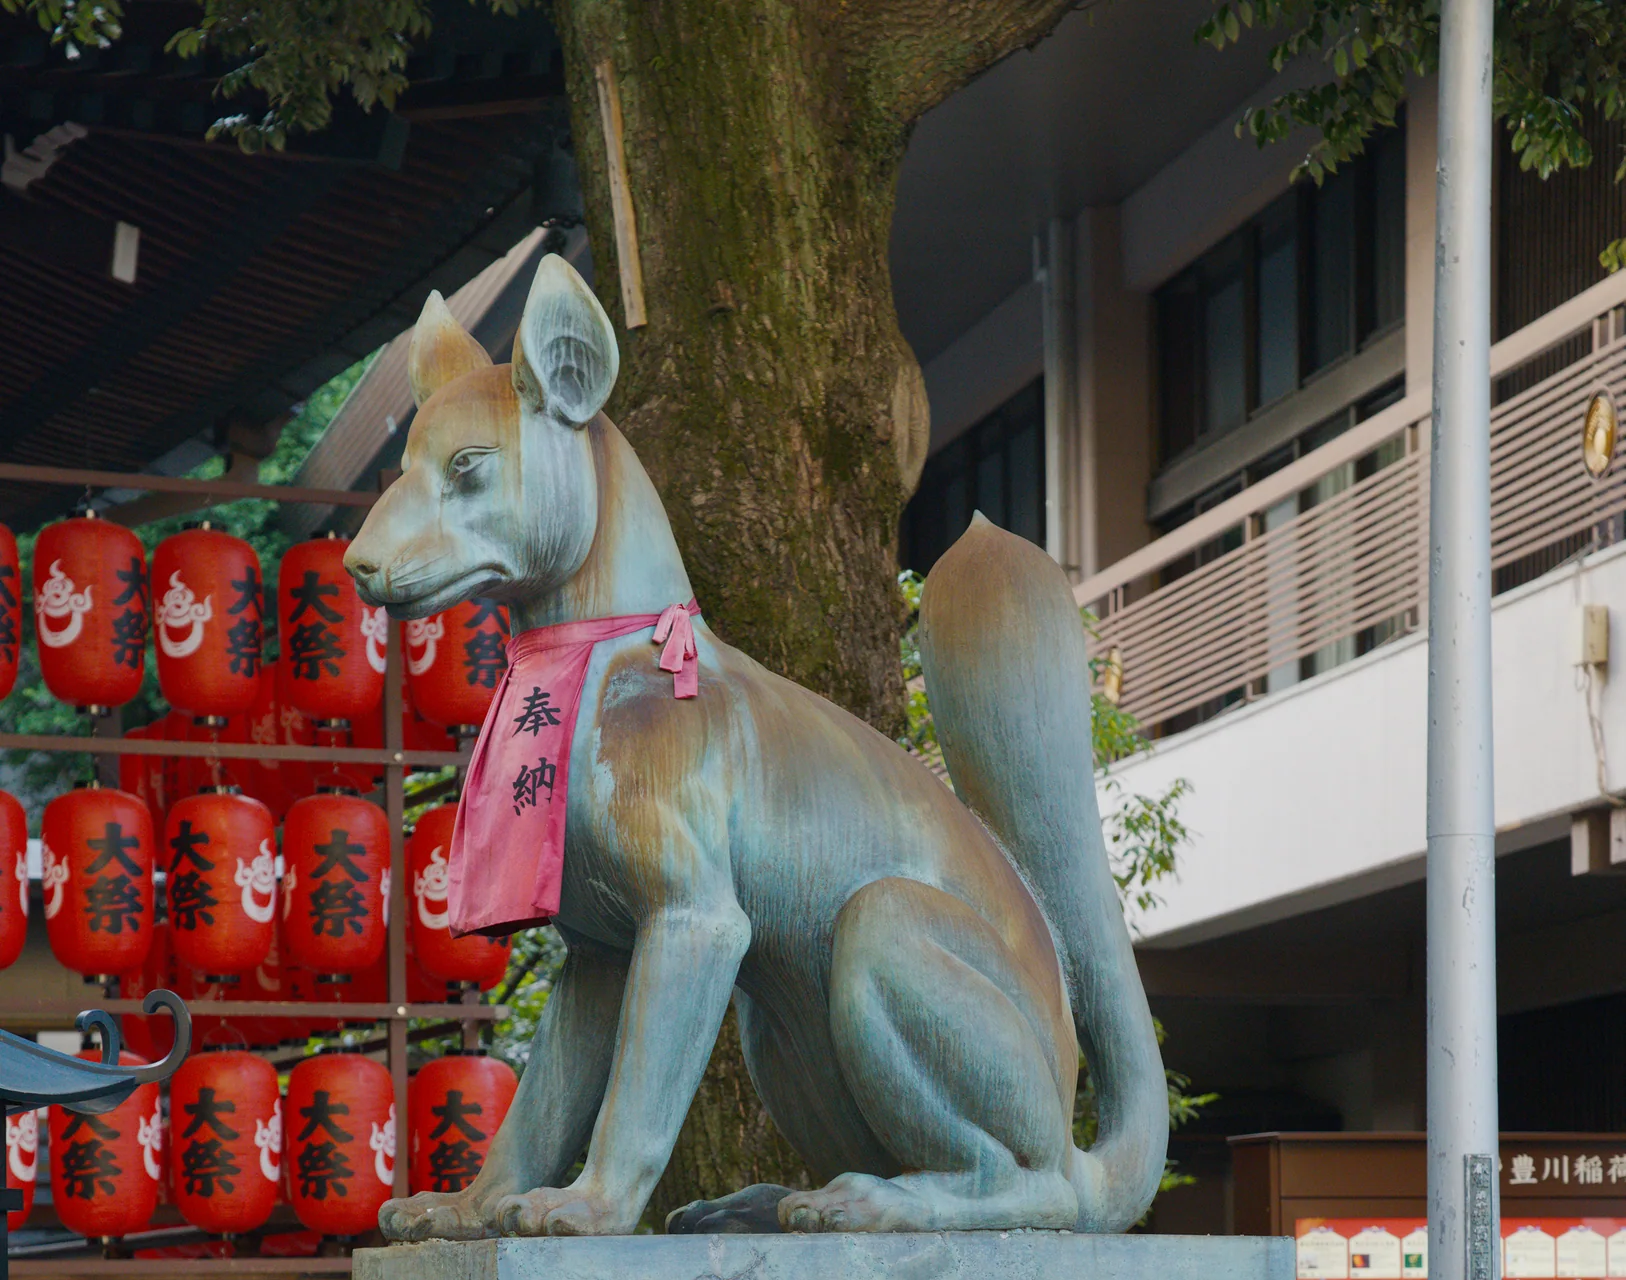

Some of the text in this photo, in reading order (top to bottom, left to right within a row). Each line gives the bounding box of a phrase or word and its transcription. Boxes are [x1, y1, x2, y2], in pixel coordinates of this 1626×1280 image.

[111, 556, 147, 670] 大祭
[227, 566, 264, 678] 大祭
[288, 570, 347, 682] 大祭
[512, 686, 561, 817] 奉納
[84, 821, 144, 935] 大祭
[168, 820, 219, 931] 大祭
[308, 828, 370, 938] 大祭
[181, 1087, 242, 1199] 大祭
[297, 1090, 355, 1200] 大祭
[429, 1090, 487, 1193] 大祭
